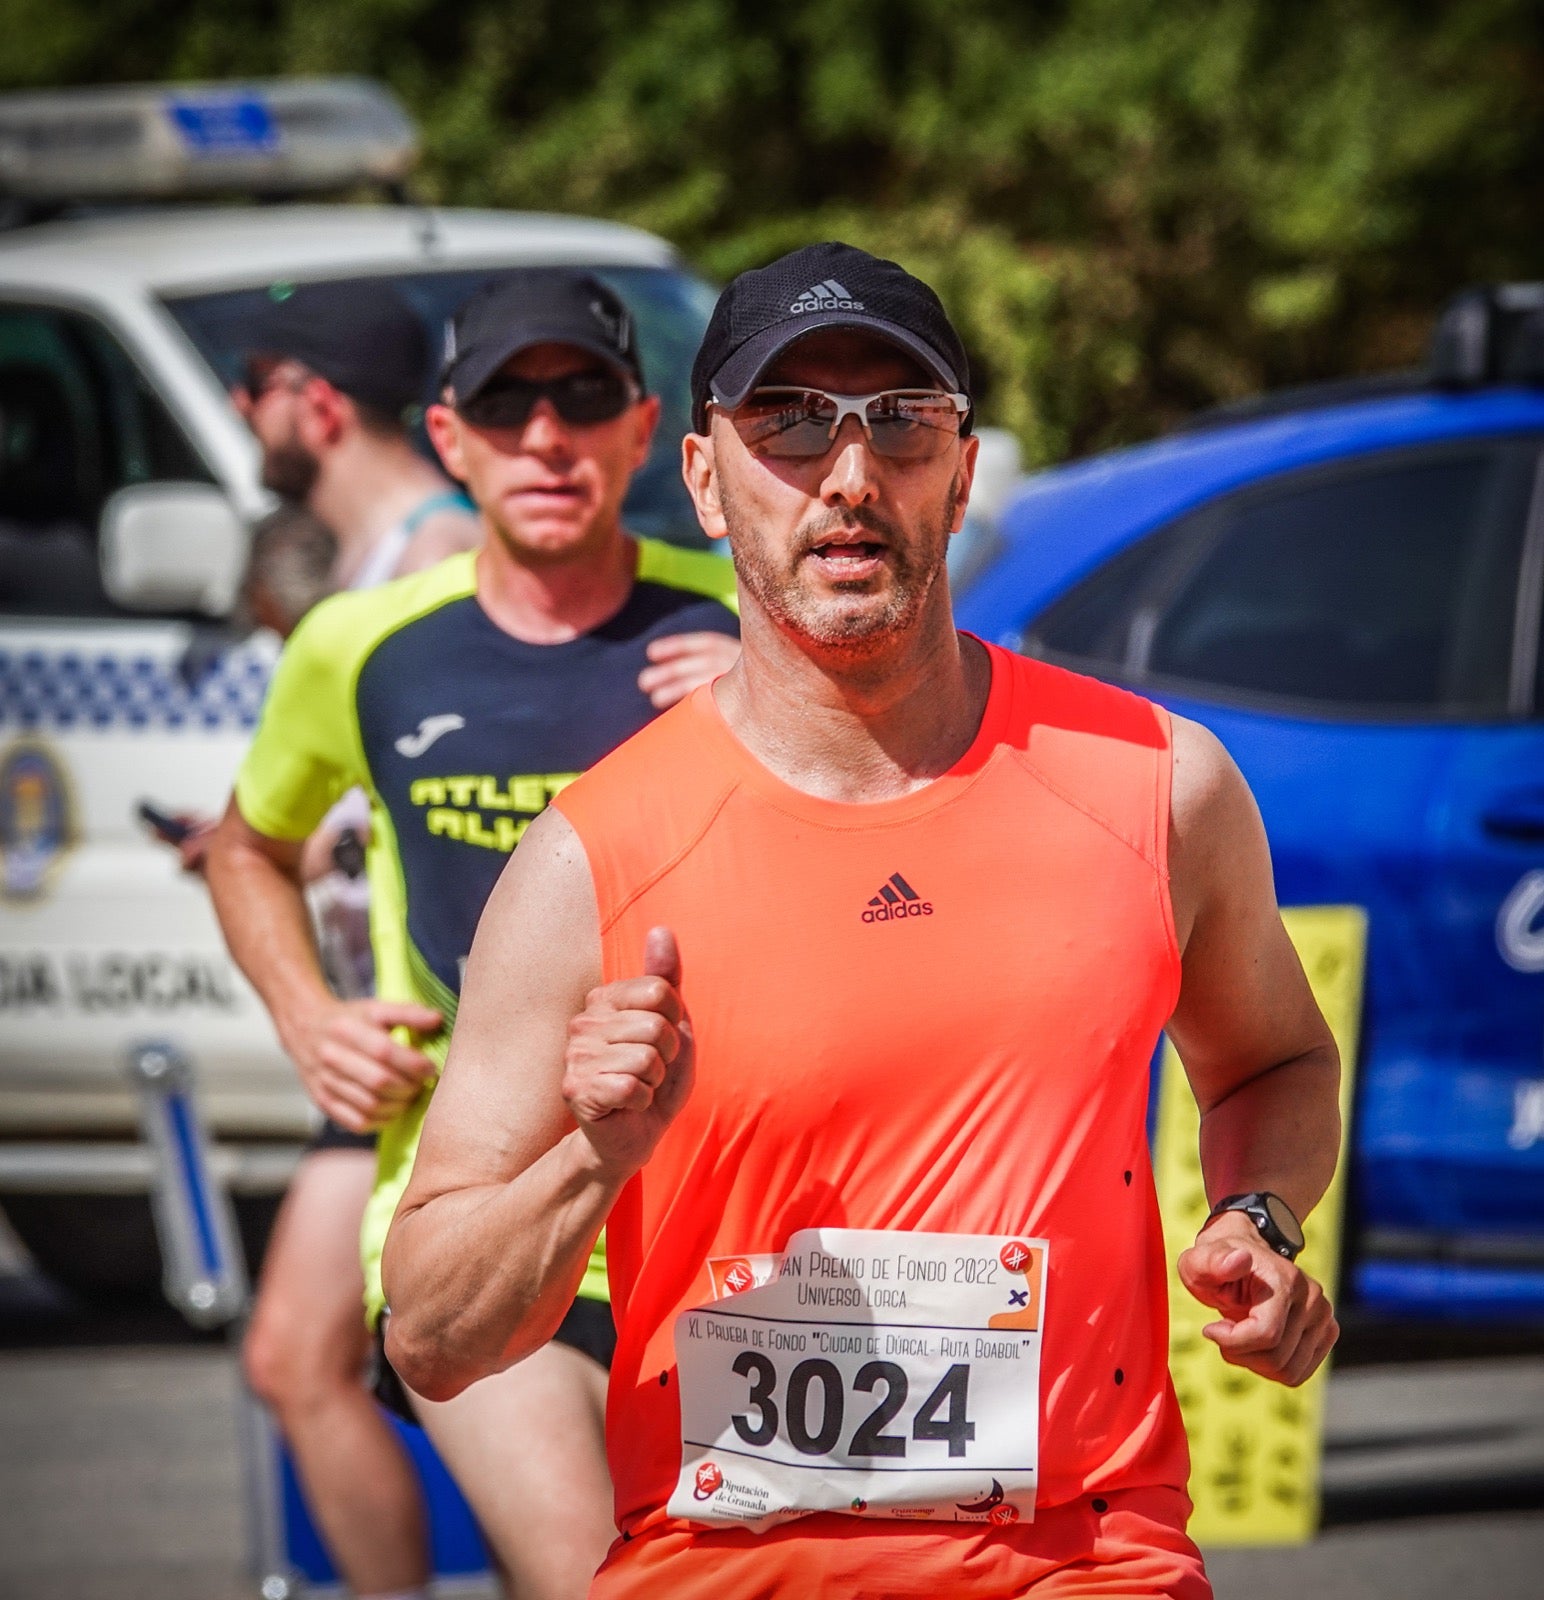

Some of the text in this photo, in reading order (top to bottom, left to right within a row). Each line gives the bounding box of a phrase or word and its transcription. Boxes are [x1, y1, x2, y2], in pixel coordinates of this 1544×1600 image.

[790, 297, 865, 314] adidas
[861, 901, 933, 923] adidas
[809, 1251, 864, 1279] PREMIO
[872, 1258, 890, 1280] DE
[897, 1255, 947, 1282] FONDO
[953, 1257, 999, 1285] 2022
[797, 1282, 907, 1308] UNIVERSO LORCA
[688, 1317, 703, 1339] XL
[707, 1320, 749, 1345] PRUEBA
[752, 1329, 764, 1348] DE
[768, 1329, 807, 1352] FONDO
[866, 1337, 881, 1355] DE
[940, 1336, 970, 1358] RUTA
[731, 1351, 976, 1458] 3024
[714, 1491, 726, 1502] de
[727, 1495, 767, 1512] Granada
